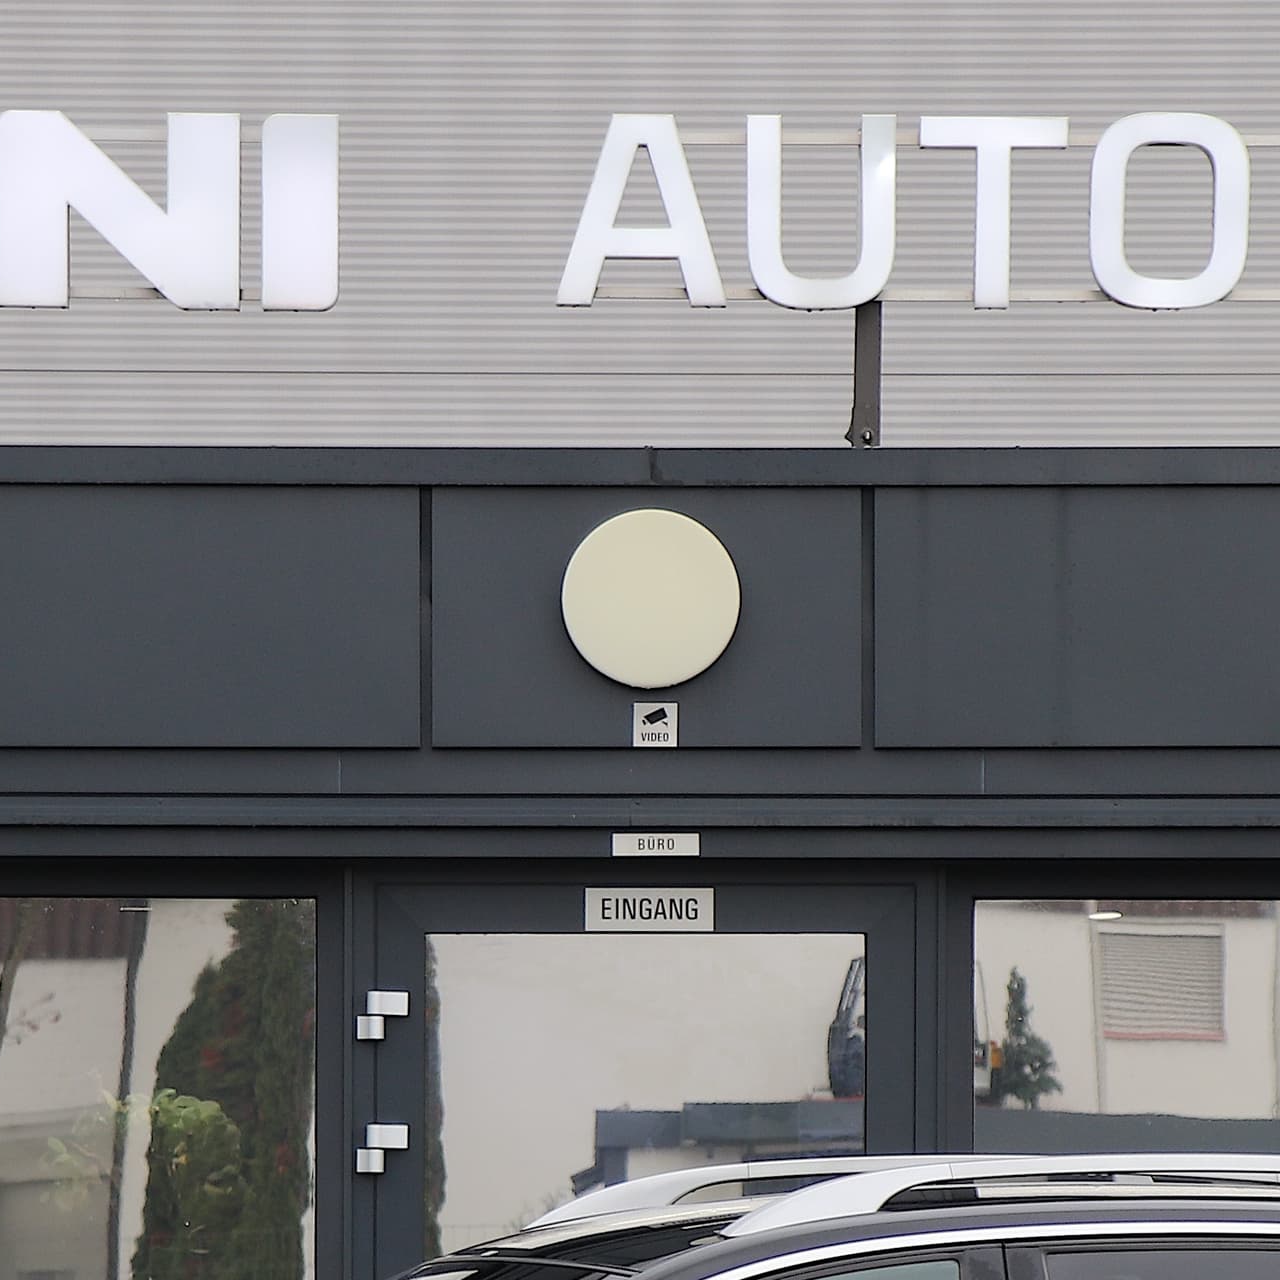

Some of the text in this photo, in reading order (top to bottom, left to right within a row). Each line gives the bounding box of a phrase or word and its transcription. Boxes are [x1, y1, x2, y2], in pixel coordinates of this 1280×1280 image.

[557, 111, 1252, 310] AUTO
[641, 732, 670, 743] VIDEO
[637, 836, 675, 851] BÜRO
[601, 898, 699, 920] EINGANG
